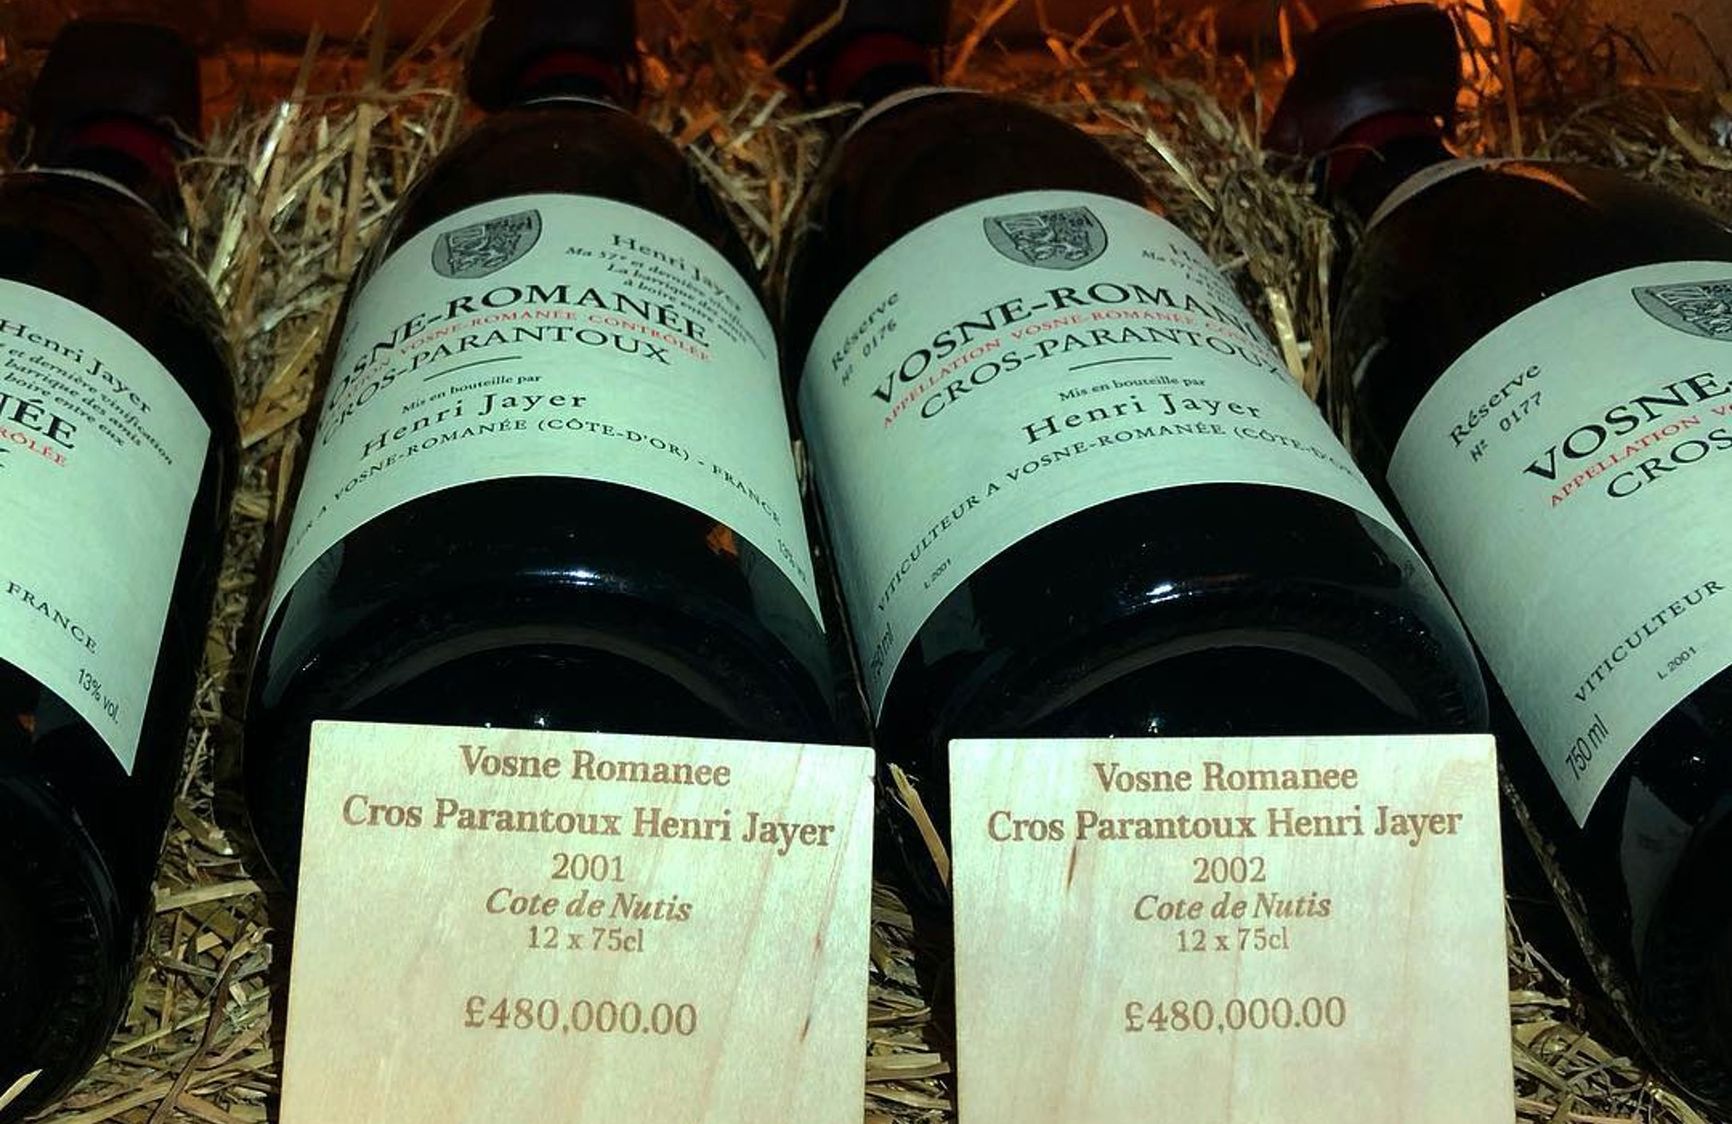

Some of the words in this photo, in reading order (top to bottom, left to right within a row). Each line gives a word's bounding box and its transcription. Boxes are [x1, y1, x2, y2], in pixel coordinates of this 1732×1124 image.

[565, 247, 592, 258] Ma
[612, 234, 686, 271] Henri
[606, 263, 629, 275] La
[633, 268, 696, 302] barrique
[638, 280, 677, 303] boire
[830, 292, 900, 373] Réserve
[0, 318, 84, 364] Henri
[86, 358, 152, 414] Jayer
[883, 338, 1002, 428] APPELLATION
[4, 358, 79, 398] barrique
[82, 397, 107, 416] des
[109, 416, 142, 447] amis
[8, 348, 26, 358] et
[29, 355, 98, 393] dernière
[95, 393, 173, 465] vinification
[401, 399, 427, 415] Mis
[429, 391, 447, 402] en
[449, 375, 514, 396] bouteille
[516, 374, 543, 387] par
[1059, 386, 1088, 402] Mis
[1097, 382, 1111, 394] en
[1113, 374, 1180, 391] bouteille
[1182, 377, 1206, 389] par
[1448, 363, 1542, 449] Réserve
[4, 372, 51, 397] boire
[54, 396, 96, 423] entre
[98, 423, 125, 447] eux
[360, 400, 464, 460] Henri
[478, 393, 587, 416] Jayer
[1022, 394, 1148, 445] Henri
[1158, 392, 1262, 420] Jayer
[1499, 390, 1542, 432] 0177
[334, 418, 528, 501] VOSNE-ROMANÉE
[538, 417, 690, 462] (CÔTE-D'OR)
[711, 463, 782, 527] FRANCE
[1550, 414, 1702, 508] APPELLATION
[878, 494, 981, 612] VITICULTEUR
[986, 481, 1001, 497] A
[1006, 421, 1227, 482] VOSNE-ROMANÉE
[6, 581, 99, 654] FRANCE
[1574, 580, 1725, 703] VITICULTEUR
[1667, 646, 1698, 672] 2001
[78, 668, 102, 700] 13%
[103, 698, 119, 725] vol.
[459, 744, 561, 779] Vosne
[572, 750, 732, 787] Romanee
[1565, 736, 1592, 781] 750
[1587, 713, 1609, 751] ml
[1093, 761, 1192, 794] Vosne
[1202, 761, 1359, 792] Romanee
[341, 793, 423, 829] Cros
[433, 798, 622, 837] Parantoux
[633, 806, 732, 841] Henri
[742, 811, 836, 856] Jayer
[987, 810, 1065, 843] Cros
[1075, 809, 1256, 841] Parantoux
[1267, 805, 1364, 838] Henri
[1374, 805, 1463, 847] Jayer
[551, 853, 626, 883] 2001
[1192, 856, 1267, 885] 2002
[486, 887, 560, 918] Cote
[565, 888, 603, 919] de
[609, 892, 693, 923] Nutis
[1133, 893, 1204, 922] Cote
[1211, 892, 1247, 919] de
[1253, 892, 1332, 919] Nutis
[528, 926, 559, 951] 12
[566, 934, 582, 951] x
[591, 927, 645, 953] 75cl
[1177, 928, 1207, 953] 12
[1215, 935, 1230, 952] x
[1238, 926, 1291, 952] 75cl
[463, 995, 698, 1037] £480,000.00
[1124, 995, 1347, 1035] £480,000.00
